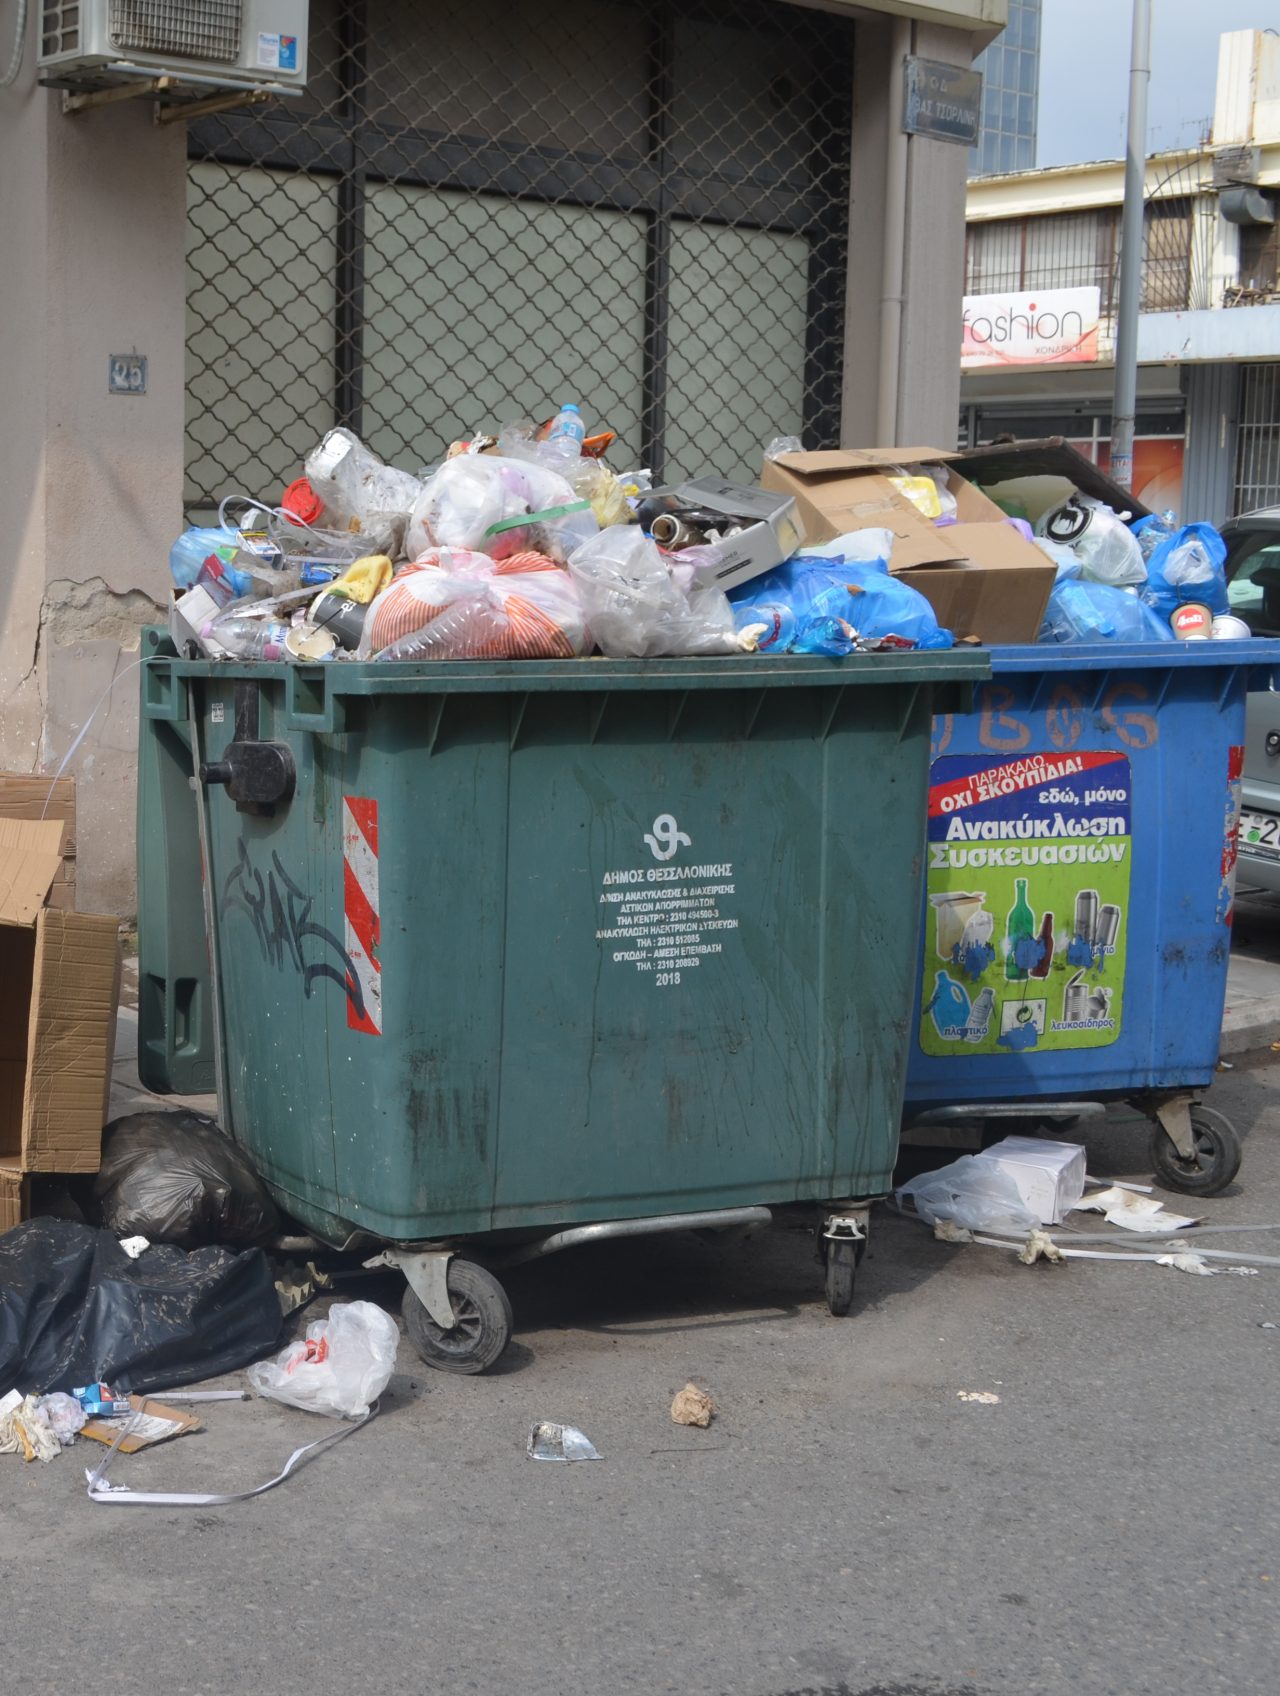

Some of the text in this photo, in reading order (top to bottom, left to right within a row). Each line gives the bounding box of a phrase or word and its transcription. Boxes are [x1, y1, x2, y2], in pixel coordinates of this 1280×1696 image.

[962, 303, 1082, 344] fashion
[968, 755, 1049, 790] ΠΑΡΑΚΑΛΩ,
[940, 791, 974, 813] ΟΧΙ
[1038, 786, 1127, 806] εδώ, μόνο
[945, 812, 1126, 841] Ανακύκλωση
[930, 837, 1127, 869] Συσκευασιών
[603, 863, 733, 885] ΔΗΜΟΣ ΘΕΣΣΑΛΟΝΙΚΗΣ
[624, 888, 682, 902] ΑΝΑΚΥΚΛΩΣΗΣ
[689, 884, 735, 897] ΔΙΑΧΕΙΡΙΣΗΣ
[620, 898, 716, 914] ΑΣΤΙΚΩΝ ΑΠΟΡΡΙΜΜΑΤΩΝ
[617, 916, 633, 926] ΤΗΛ
[634, 912, 665, 924] ΚΕΝΤΡΟ
[670, 911, 687, 922] 2310
[596, 919, 739, 939] ΑΝΑΚΥΚΛΩΣΗ ΗΛΕΚΤΡΙΚΩΝ ΣΥΣΚΕΥΩΝ
[636, 938, 652, 948] ΤΗΛ
[657, 936, 674, 946] 2310
[613, 949, 646, 962] ΟΓΚΩΔΗ
[653, 947, 680, 958] ΑΜΕΣΗ
[680, 943, 722, 956] ΕΠΕΜΒΑΣΗ
[636, 961, 652, 971] ΤΗΛ
[657, 959, 675, 970] 2310
[656, 972, 681, 986] 2018
[1051, 1017, 1114, 1032] λευκοσίδηρος
